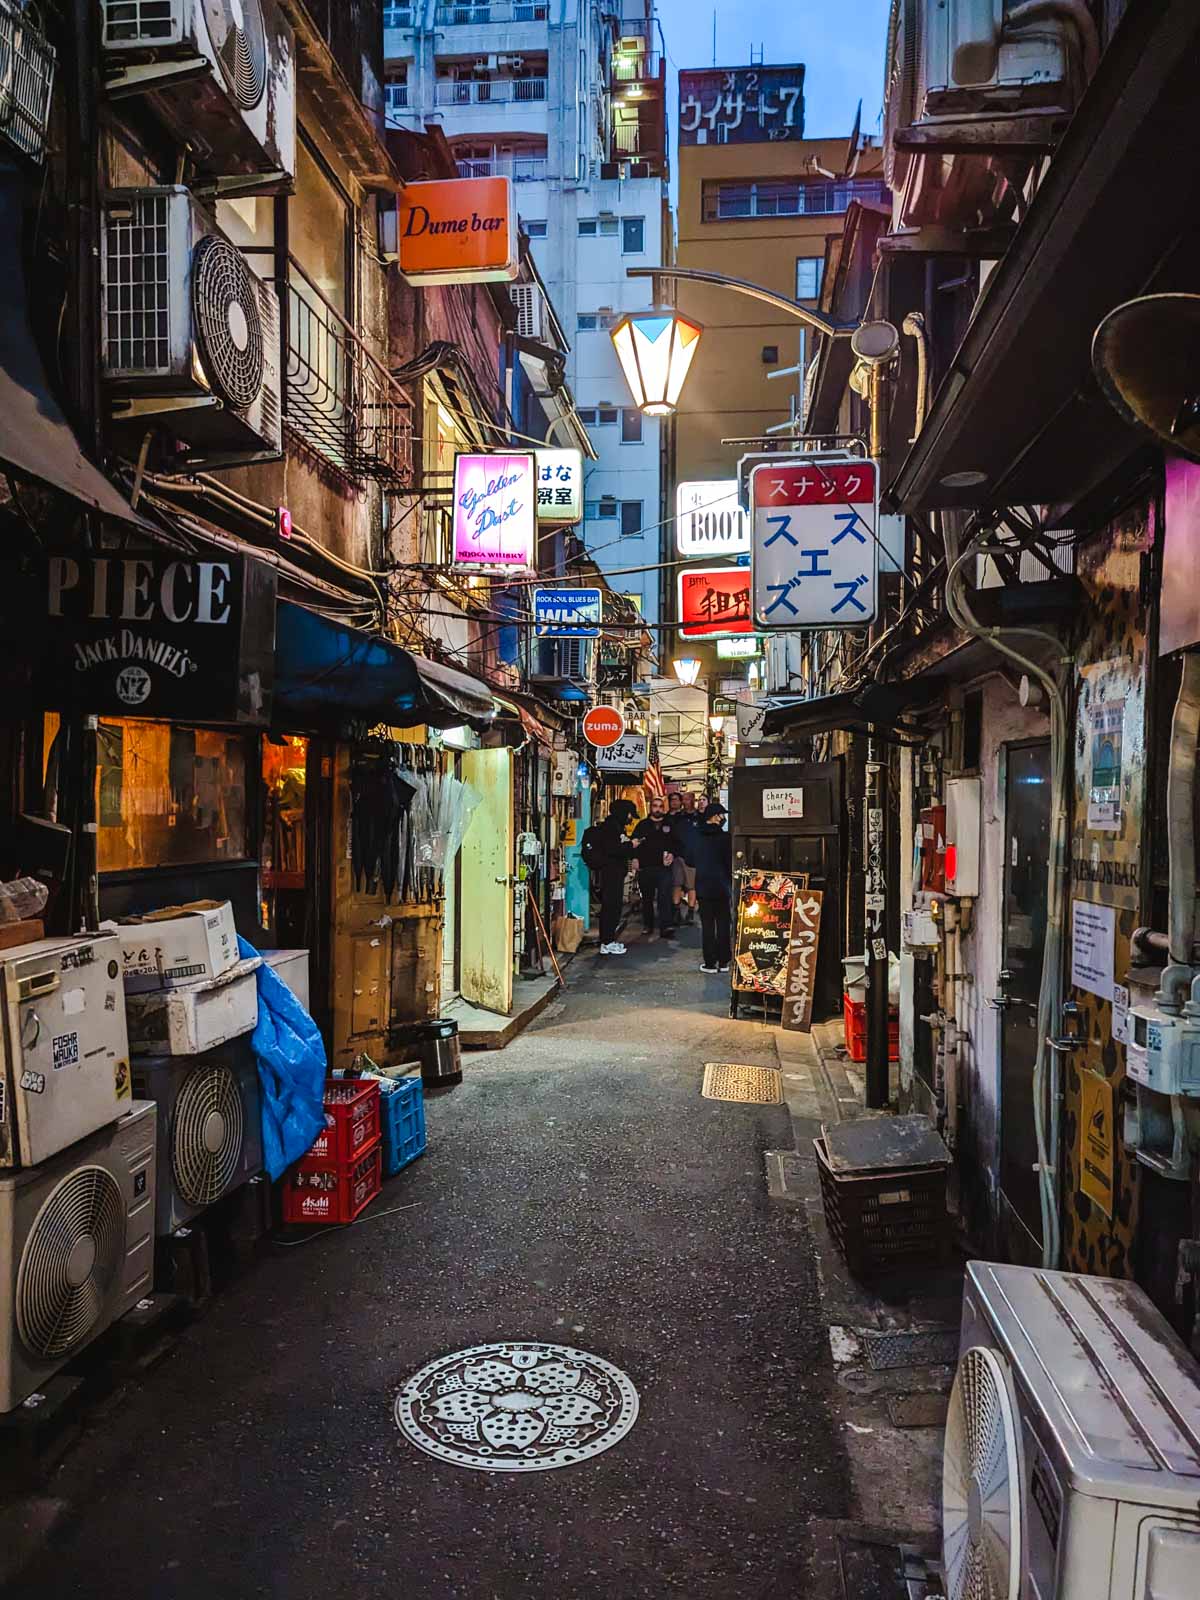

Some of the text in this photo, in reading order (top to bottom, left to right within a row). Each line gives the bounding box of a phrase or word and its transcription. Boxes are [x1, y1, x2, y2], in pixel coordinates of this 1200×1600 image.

[403, 206, 504, 237] Dume bar
[459, 473, 523, 520] Golden
[769, 474, 861, 497] スナック
[472, 498, 523, 540] Dust
[48, 557, 231, 624] PIECE
[75, 636, 116, 671] JACK
[628, 711, 646, 721] BAR
[791, 897, 821, 1024] やってます
[303, 1196, 329, 1208] Asahi
